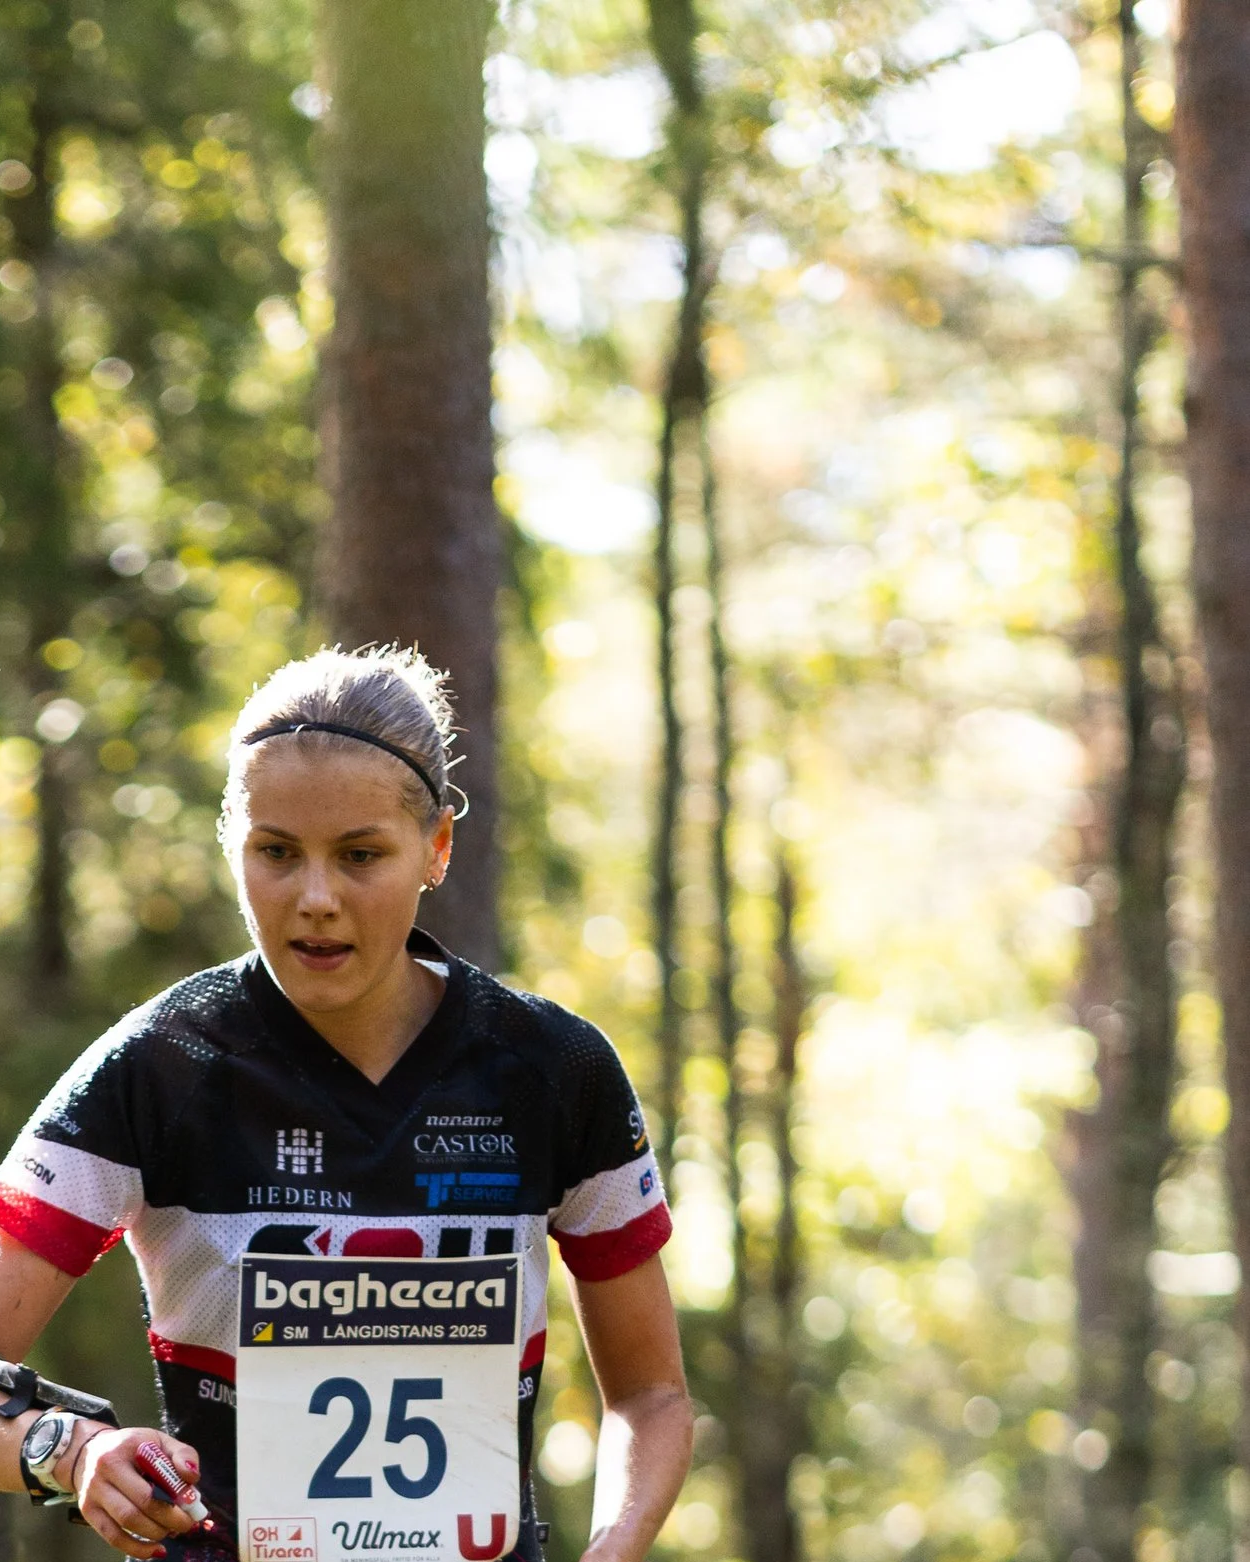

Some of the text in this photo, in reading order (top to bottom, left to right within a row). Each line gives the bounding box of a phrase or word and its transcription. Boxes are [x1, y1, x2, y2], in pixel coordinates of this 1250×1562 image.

[426, 1115, 503, 1126] noname
[413, 1133, 516, 1154] CASTOR
[248, 1186, 352, 1208] HEDERN
[453, 1186, 517, 1202] SERVICE
[254, 1271, 506, 1315] bagheera
[283, 1323, 487, 1340] SM LÅNGDISTANS 2025
[307, 1377, 447, 1499] 25
[332, 1521, 441, 1551] Ullmax
[253, 1543, 315, 1559] Tisaren
